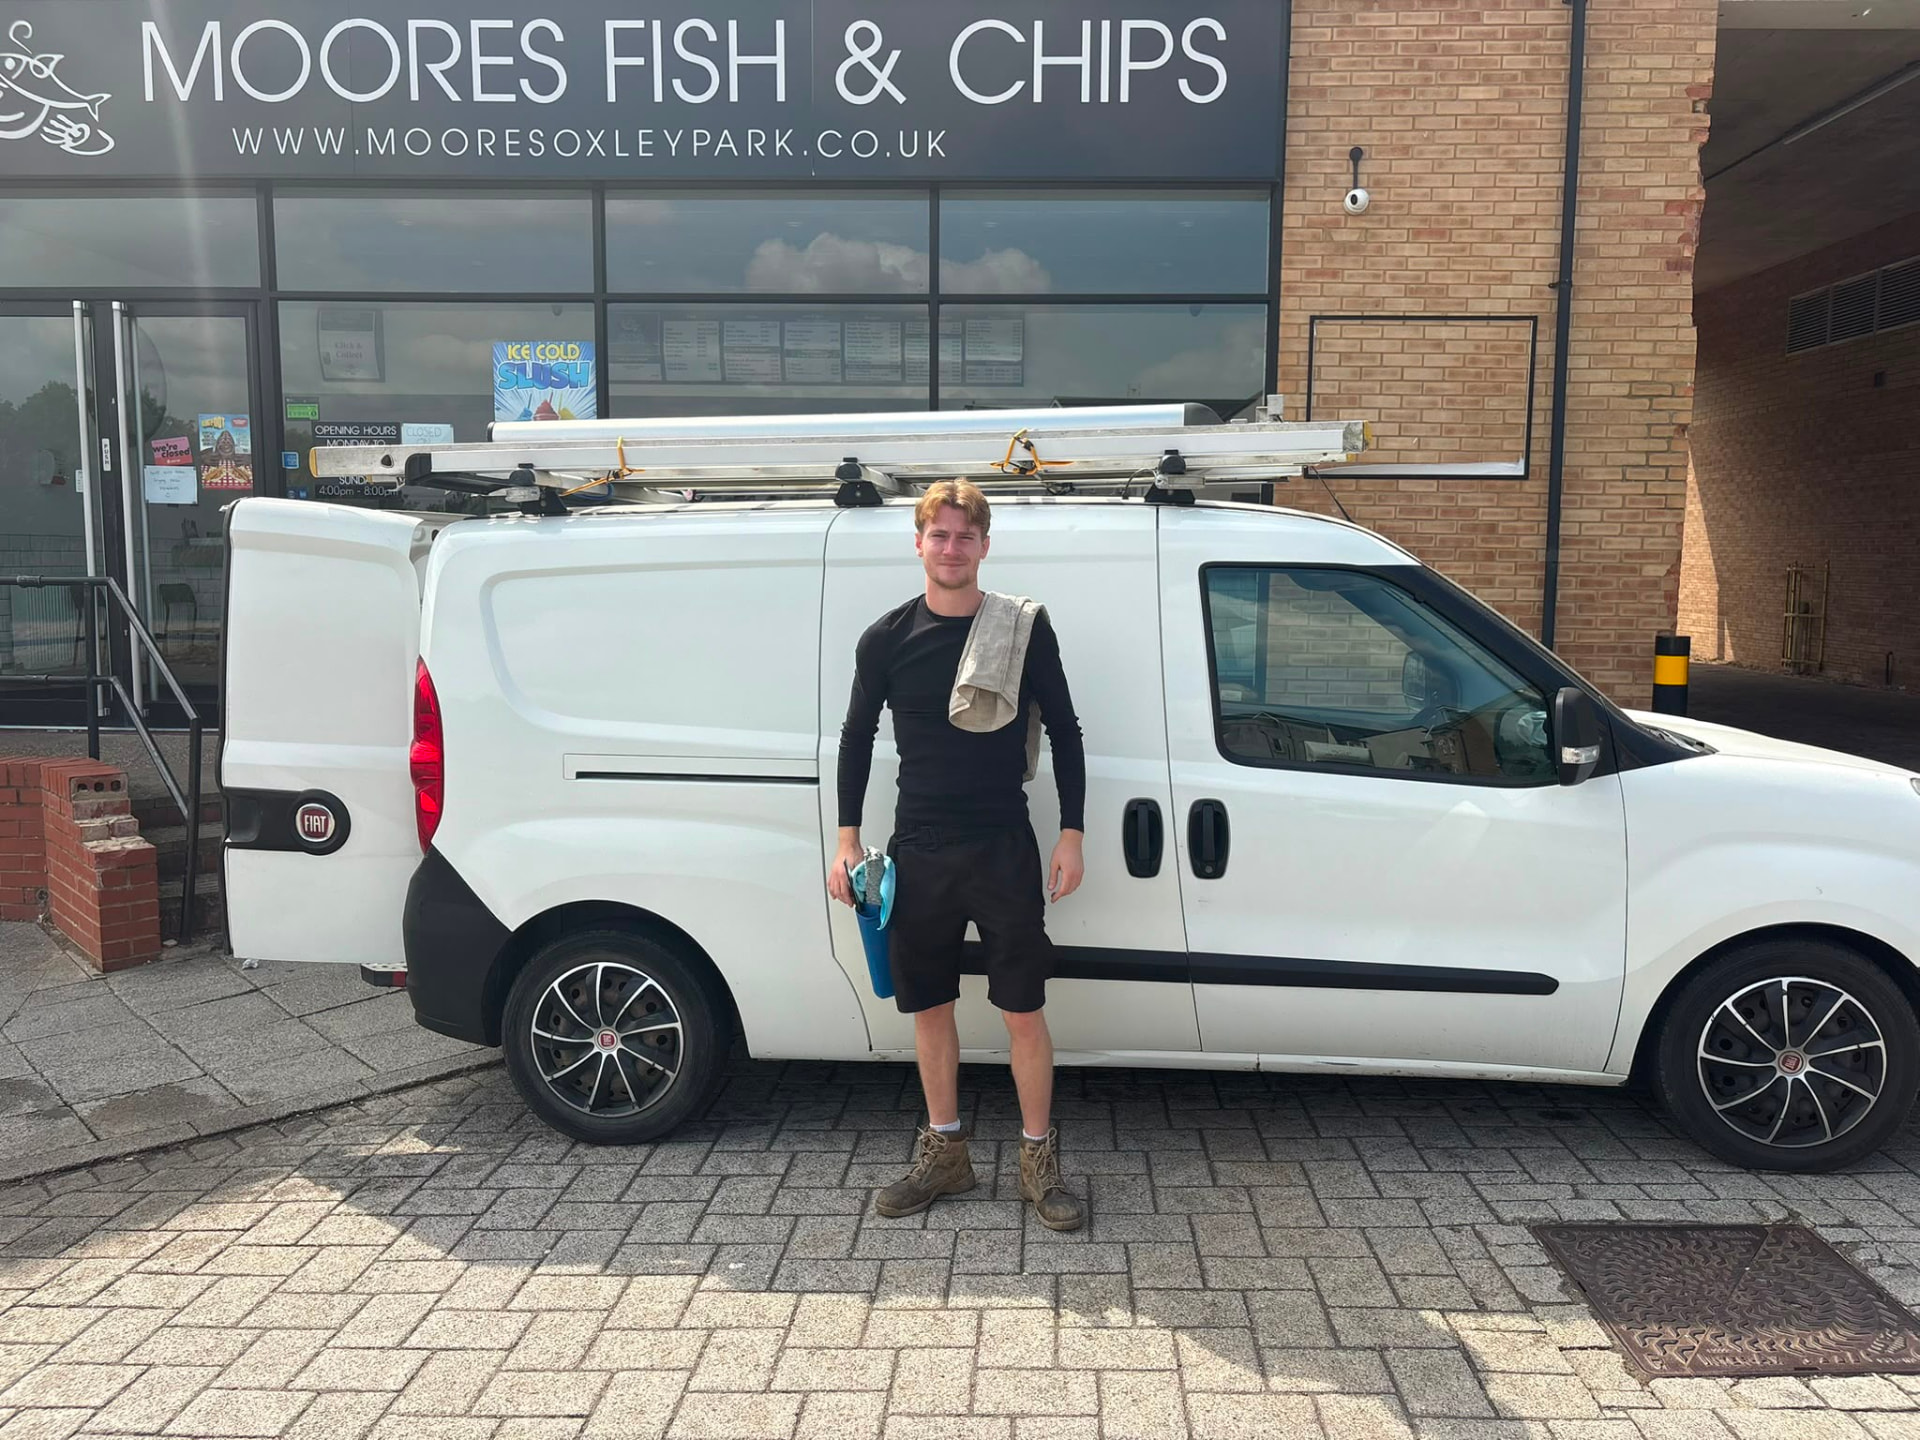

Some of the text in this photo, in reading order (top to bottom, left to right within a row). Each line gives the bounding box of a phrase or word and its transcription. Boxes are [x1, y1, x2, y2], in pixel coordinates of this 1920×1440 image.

[141, 17, 1228, 105] MOORES FISH & CHIPS
[232, 127, 947, 158] WWW.MOORESOXLEYPARK.CO.UK
[507, 343, 580, 360] ICE COLD
[498, 361, 590, 390] SLUSH
[314, 425, 397, 436] OPENING HOURS
[405, 426, 442, 437] CLOSED
[152, 443, 178, 453] we're
[161, 447, 190, 458] closed
[339, 474, 367, 485] SUND
[318, 485, 355, 497] 4:00pm
[363, 485, 399, 497] 8:00pm
[304, 814, 327, 833] FIAT
